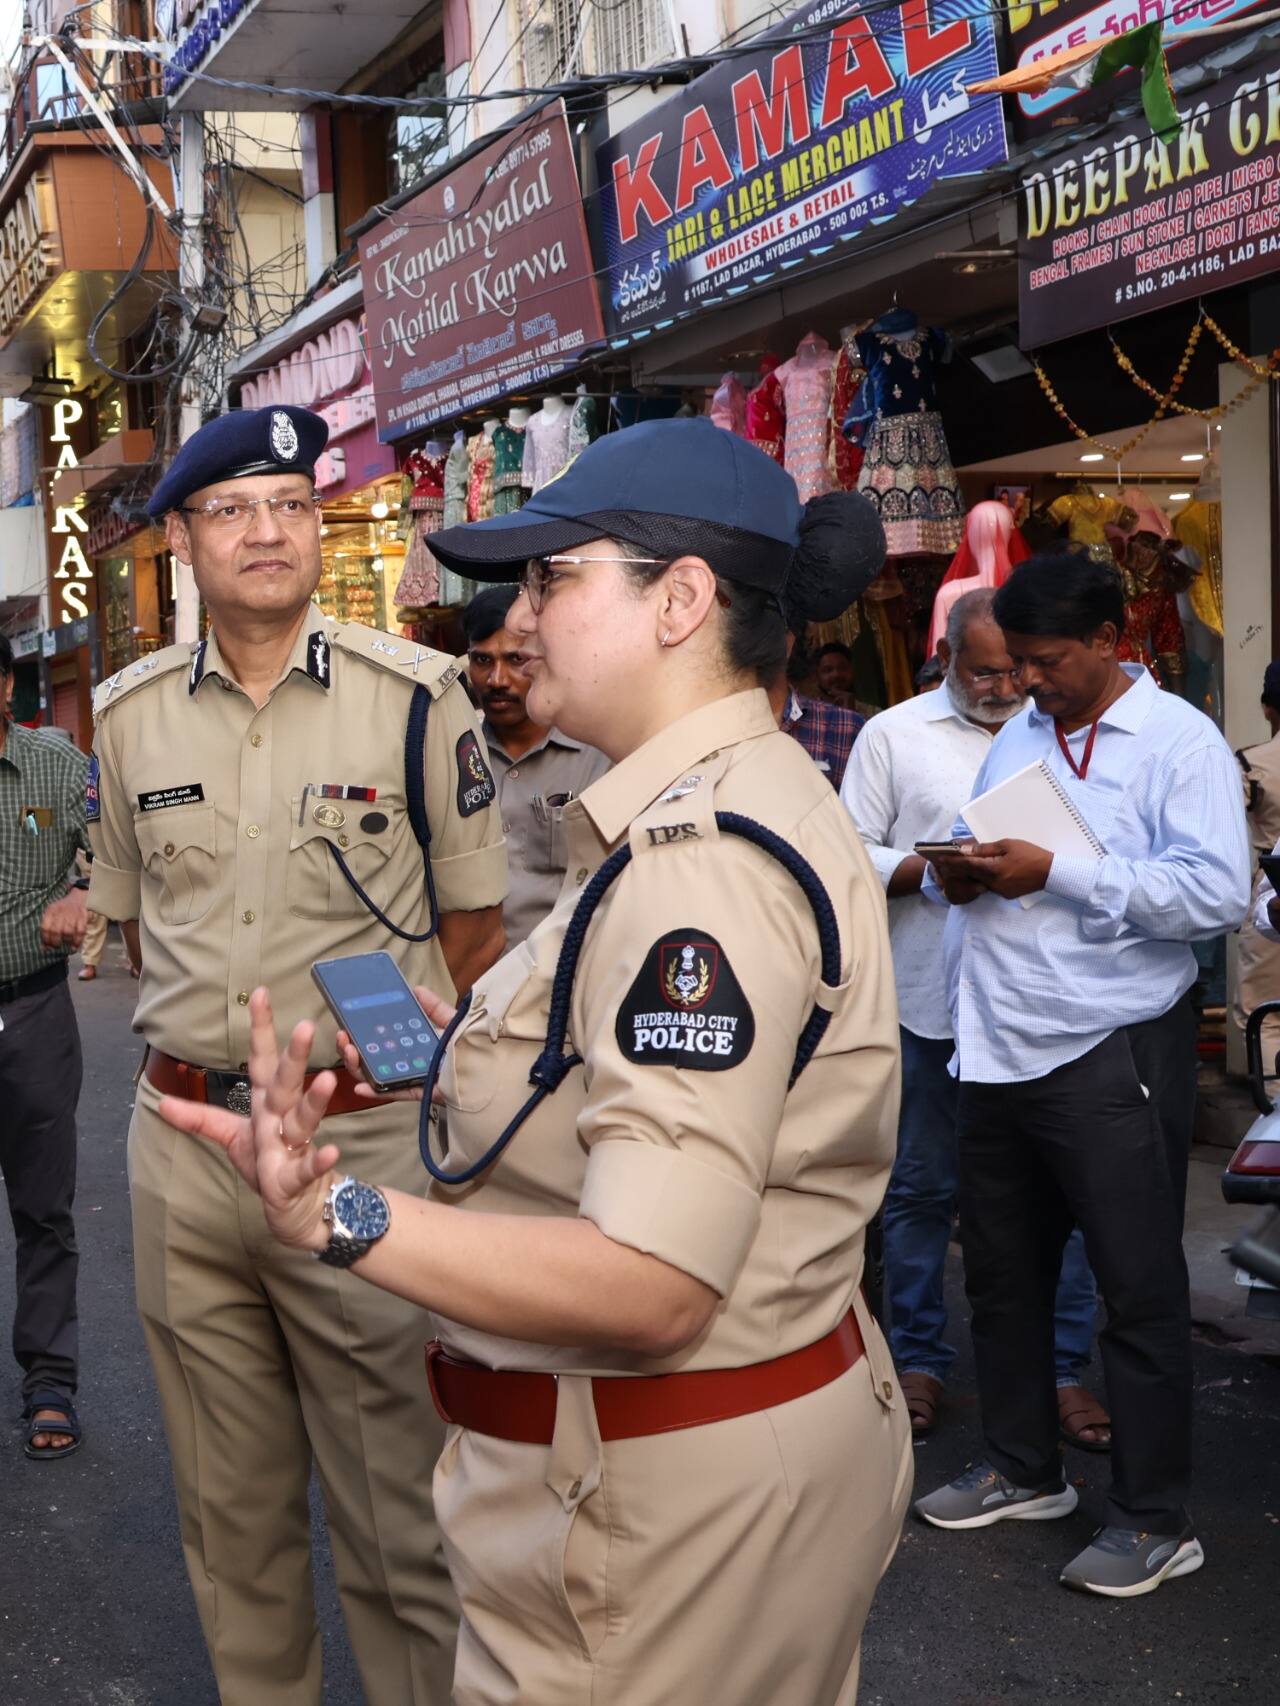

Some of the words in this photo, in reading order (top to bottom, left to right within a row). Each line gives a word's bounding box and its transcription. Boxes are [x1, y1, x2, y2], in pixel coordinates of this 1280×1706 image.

[612, 0, 971, 244] KAMAL
[727, 171, 777, 229] LACE
[780, 98, 905, 200] MERCHANT
[1022, 102, 1211, 240] DEEPAK
[1053, 227, 1089, 259] HOOKS
[1097, 215, 1131, 242] CHAIN
[1133, 198, 1167, 227] HOOK
[1175, 188, 1192, 213] AD
[1194, 175, 1223, 205] PIPE
[1233, 155, 1274, 190] MICRO
[375, 158, 553, 300] Kanahiyalal
[691, 280, 713, 300] 1187,
[715, 273, 731, 291] LAD
[732, 256, 765, 286] BAZAR,
[766, 227, 821, 262] HYDERABAD
[829, 213, 848, 232] 500
[850, 204, 868, 223] 002
[870, 192, 889, 211] T.S.
[705, 218, 787, 271] WHOLESALE
[789, 213, 799, 227] &
[804, 180, 855, 221] RETAIL
[1030, 261, 1069, 290] BENGAL
[1071, 243, 1113, 276] FRAMES
[1121, 230, 1145, 256] SUN
[1147, 218, 1185, 247] STONE
[1194, 191, 1252, 230] GARNETS
[1126, 278, 1157, 300] S.NO.
[1161, 255, 1225, 287] 20-4-1186,
[1229, 243, 1255, 265] LAD
[1136, 236, 1196, 276] NECKLACE
[1205, 221, 1236, 251] DORI
[1246, 206, 1280, 237] FANC
[380, 280, 461, 368] Motilal
[465, 241, 568, 317] Karwa
[559, 328, 585, 351] DRESSES
[462, 383, 500, 408] HYDERABAD
[144, 801, 165, 810] VIKRAM
[165, 798, 182, 806] SINGH
[633, 1012, 705, 1030] HYDERABAD
[708, 1015, 738, 1032] CITY
[633, 1027, 734, 1055] POLICE
